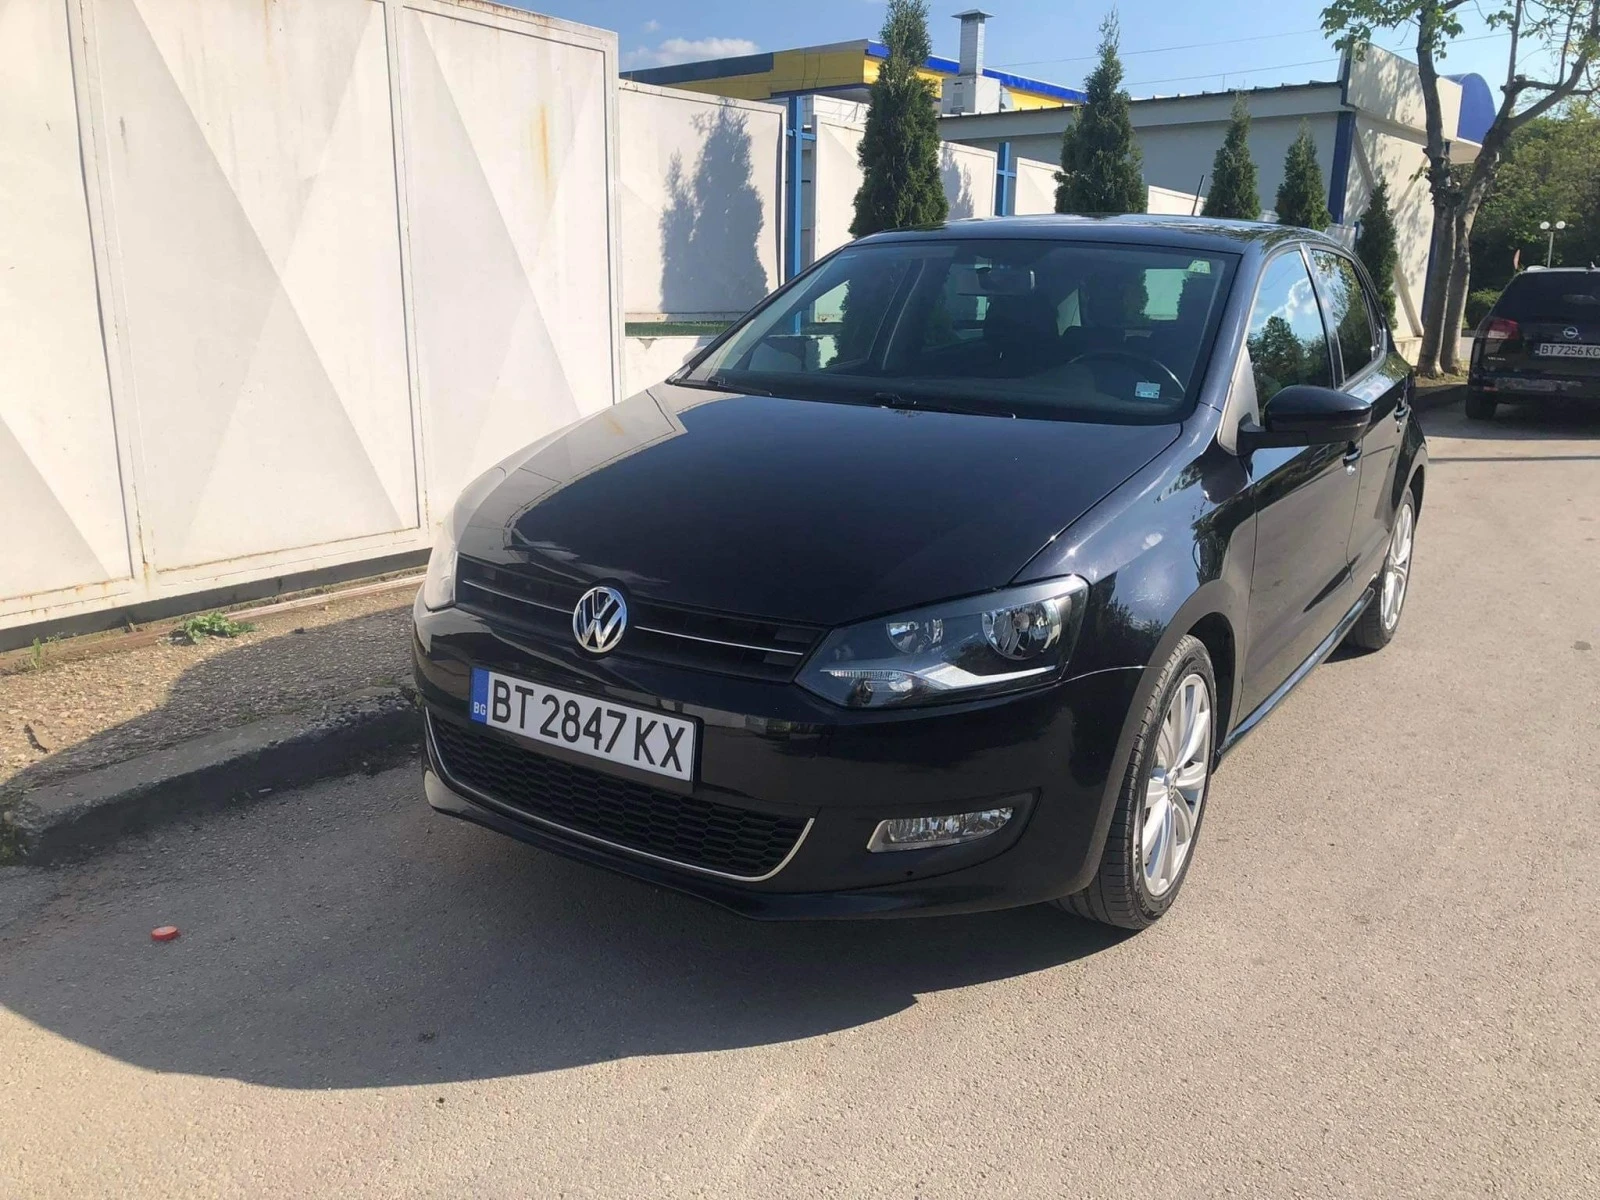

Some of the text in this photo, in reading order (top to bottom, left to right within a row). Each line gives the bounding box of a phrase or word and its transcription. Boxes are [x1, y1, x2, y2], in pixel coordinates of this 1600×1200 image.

[1541, 345, 1556, 354] BT
[1557, 345, 1583, 355] 7256
[573, 586, 627, 653] VW
[473, 701, 487, 716] BG
[492, 679, 686, 773] BT 2847 KX
